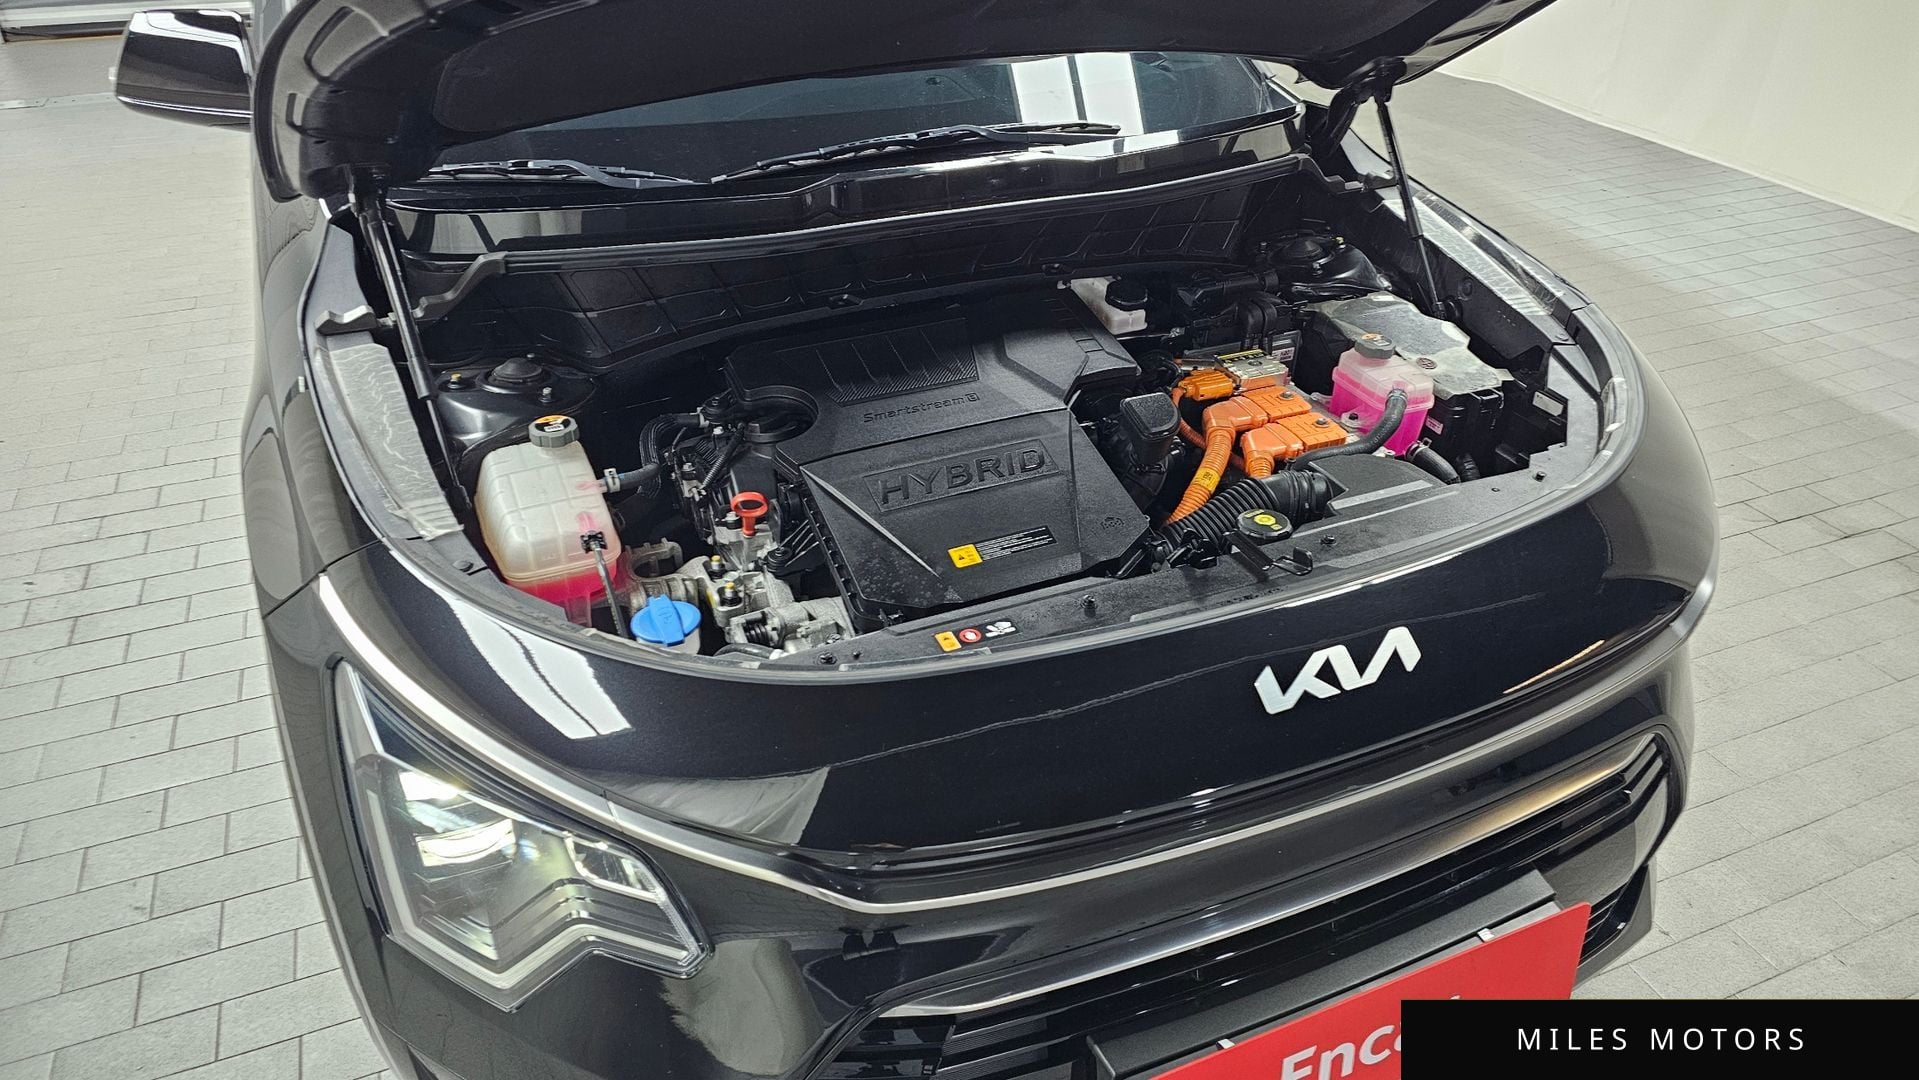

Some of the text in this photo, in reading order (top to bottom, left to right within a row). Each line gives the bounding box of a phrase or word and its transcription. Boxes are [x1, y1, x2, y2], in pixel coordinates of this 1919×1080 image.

[863, 397, 966, 423] Smartstream
[878, 449, 1046, 505] HYBRID
[1254, 625, 1422, 715] KIA
[1281, 1022, 1402, 1080] Enc
